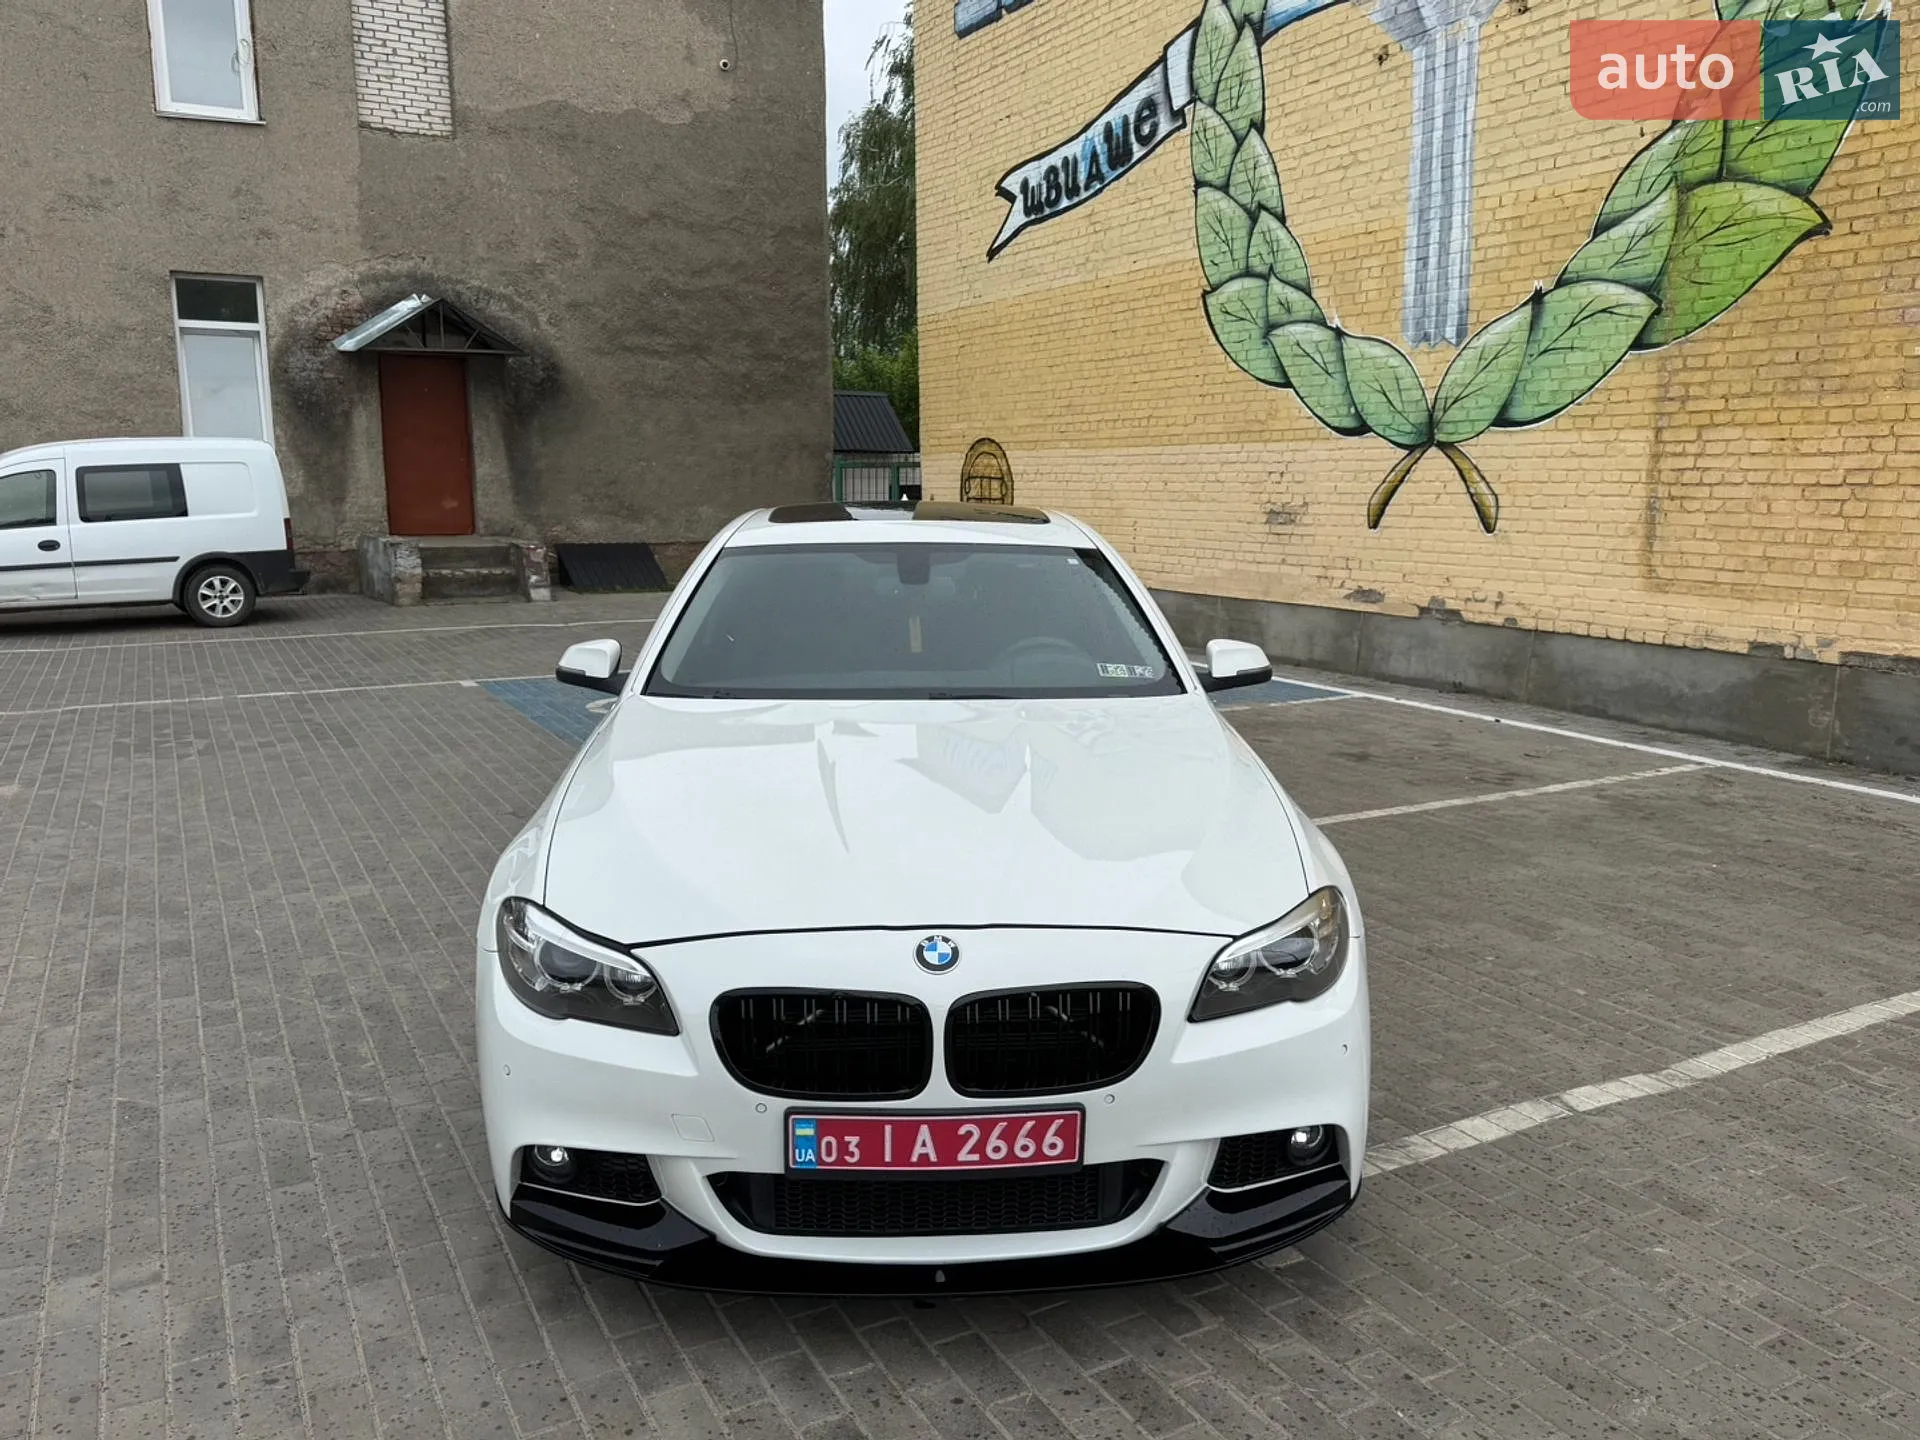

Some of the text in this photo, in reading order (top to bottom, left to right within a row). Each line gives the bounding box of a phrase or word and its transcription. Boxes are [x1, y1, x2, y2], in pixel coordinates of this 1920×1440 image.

[795, 1148, 816, 1162] UA
[820, 1136, 861, 1163] 03
[957, 1119, 1065, 1162] 2666
